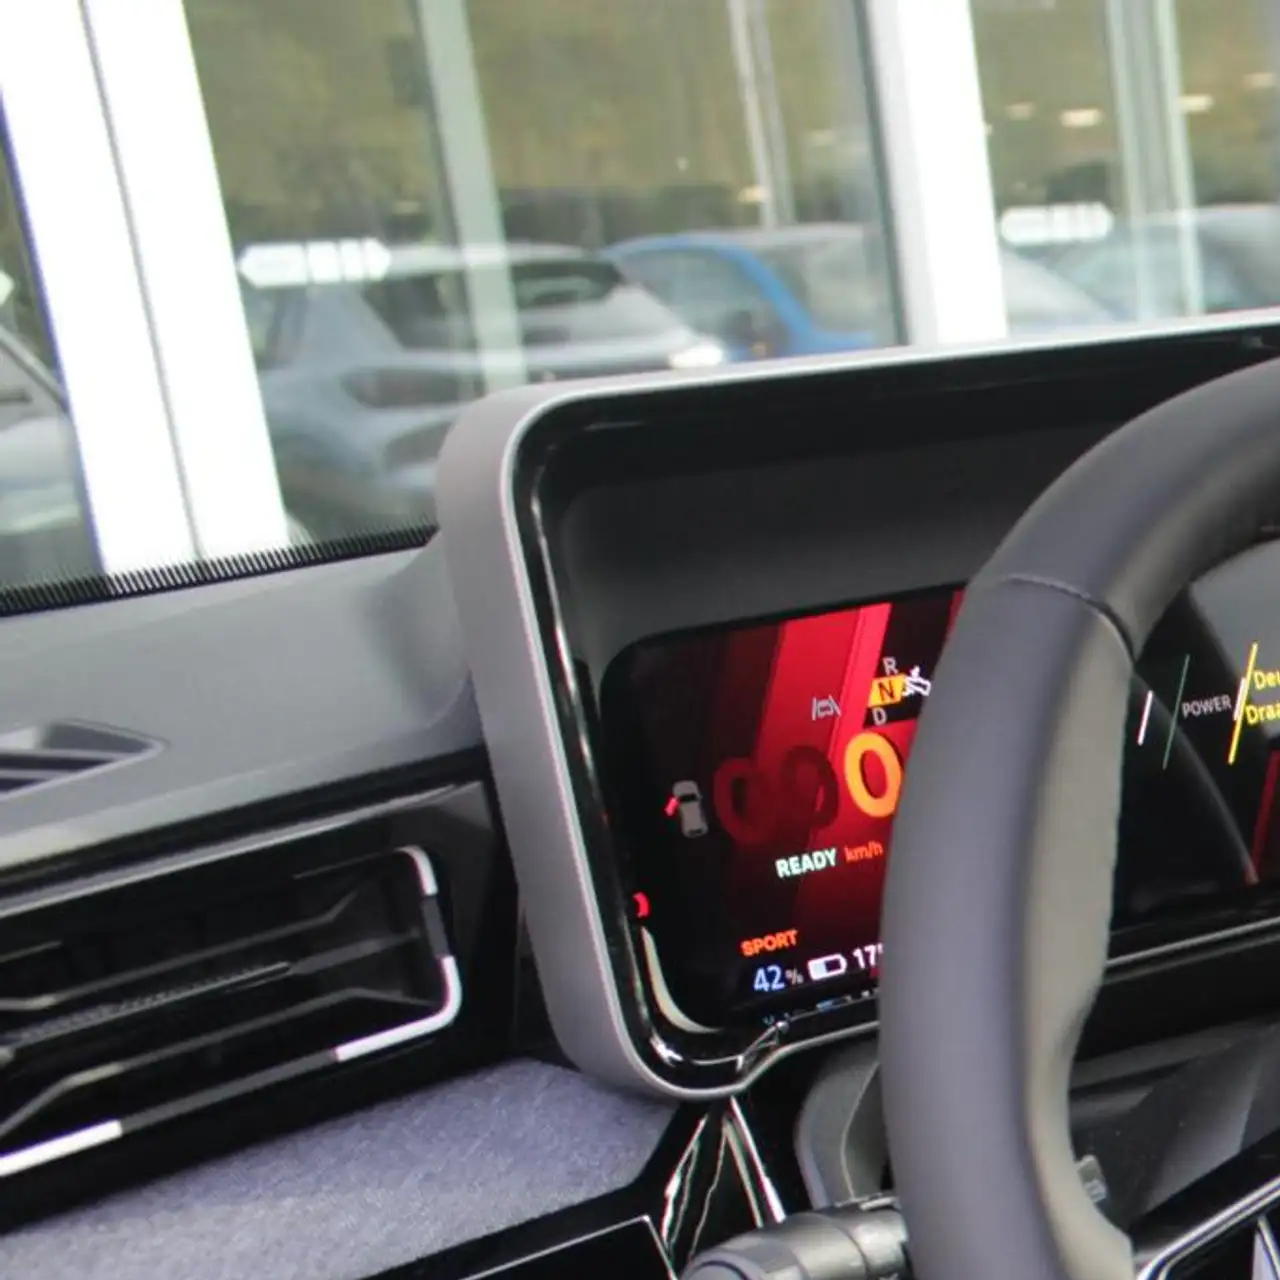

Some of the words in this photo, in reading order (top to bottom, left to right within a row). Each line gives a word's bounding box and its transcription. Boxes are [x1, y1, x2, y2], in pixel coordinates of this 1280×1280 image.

[883, 656, 899, 676] R
[878, 680, 895, 702] N
[872, 706, 888, 726] D
[1181, 694, 1232, 718] POWER
[843, 731, 904, 818] 0
[775, 848, 837, 878] READY
[844, 840, 884, 863] km/h
[740, 928, 798, 957] SPORT
